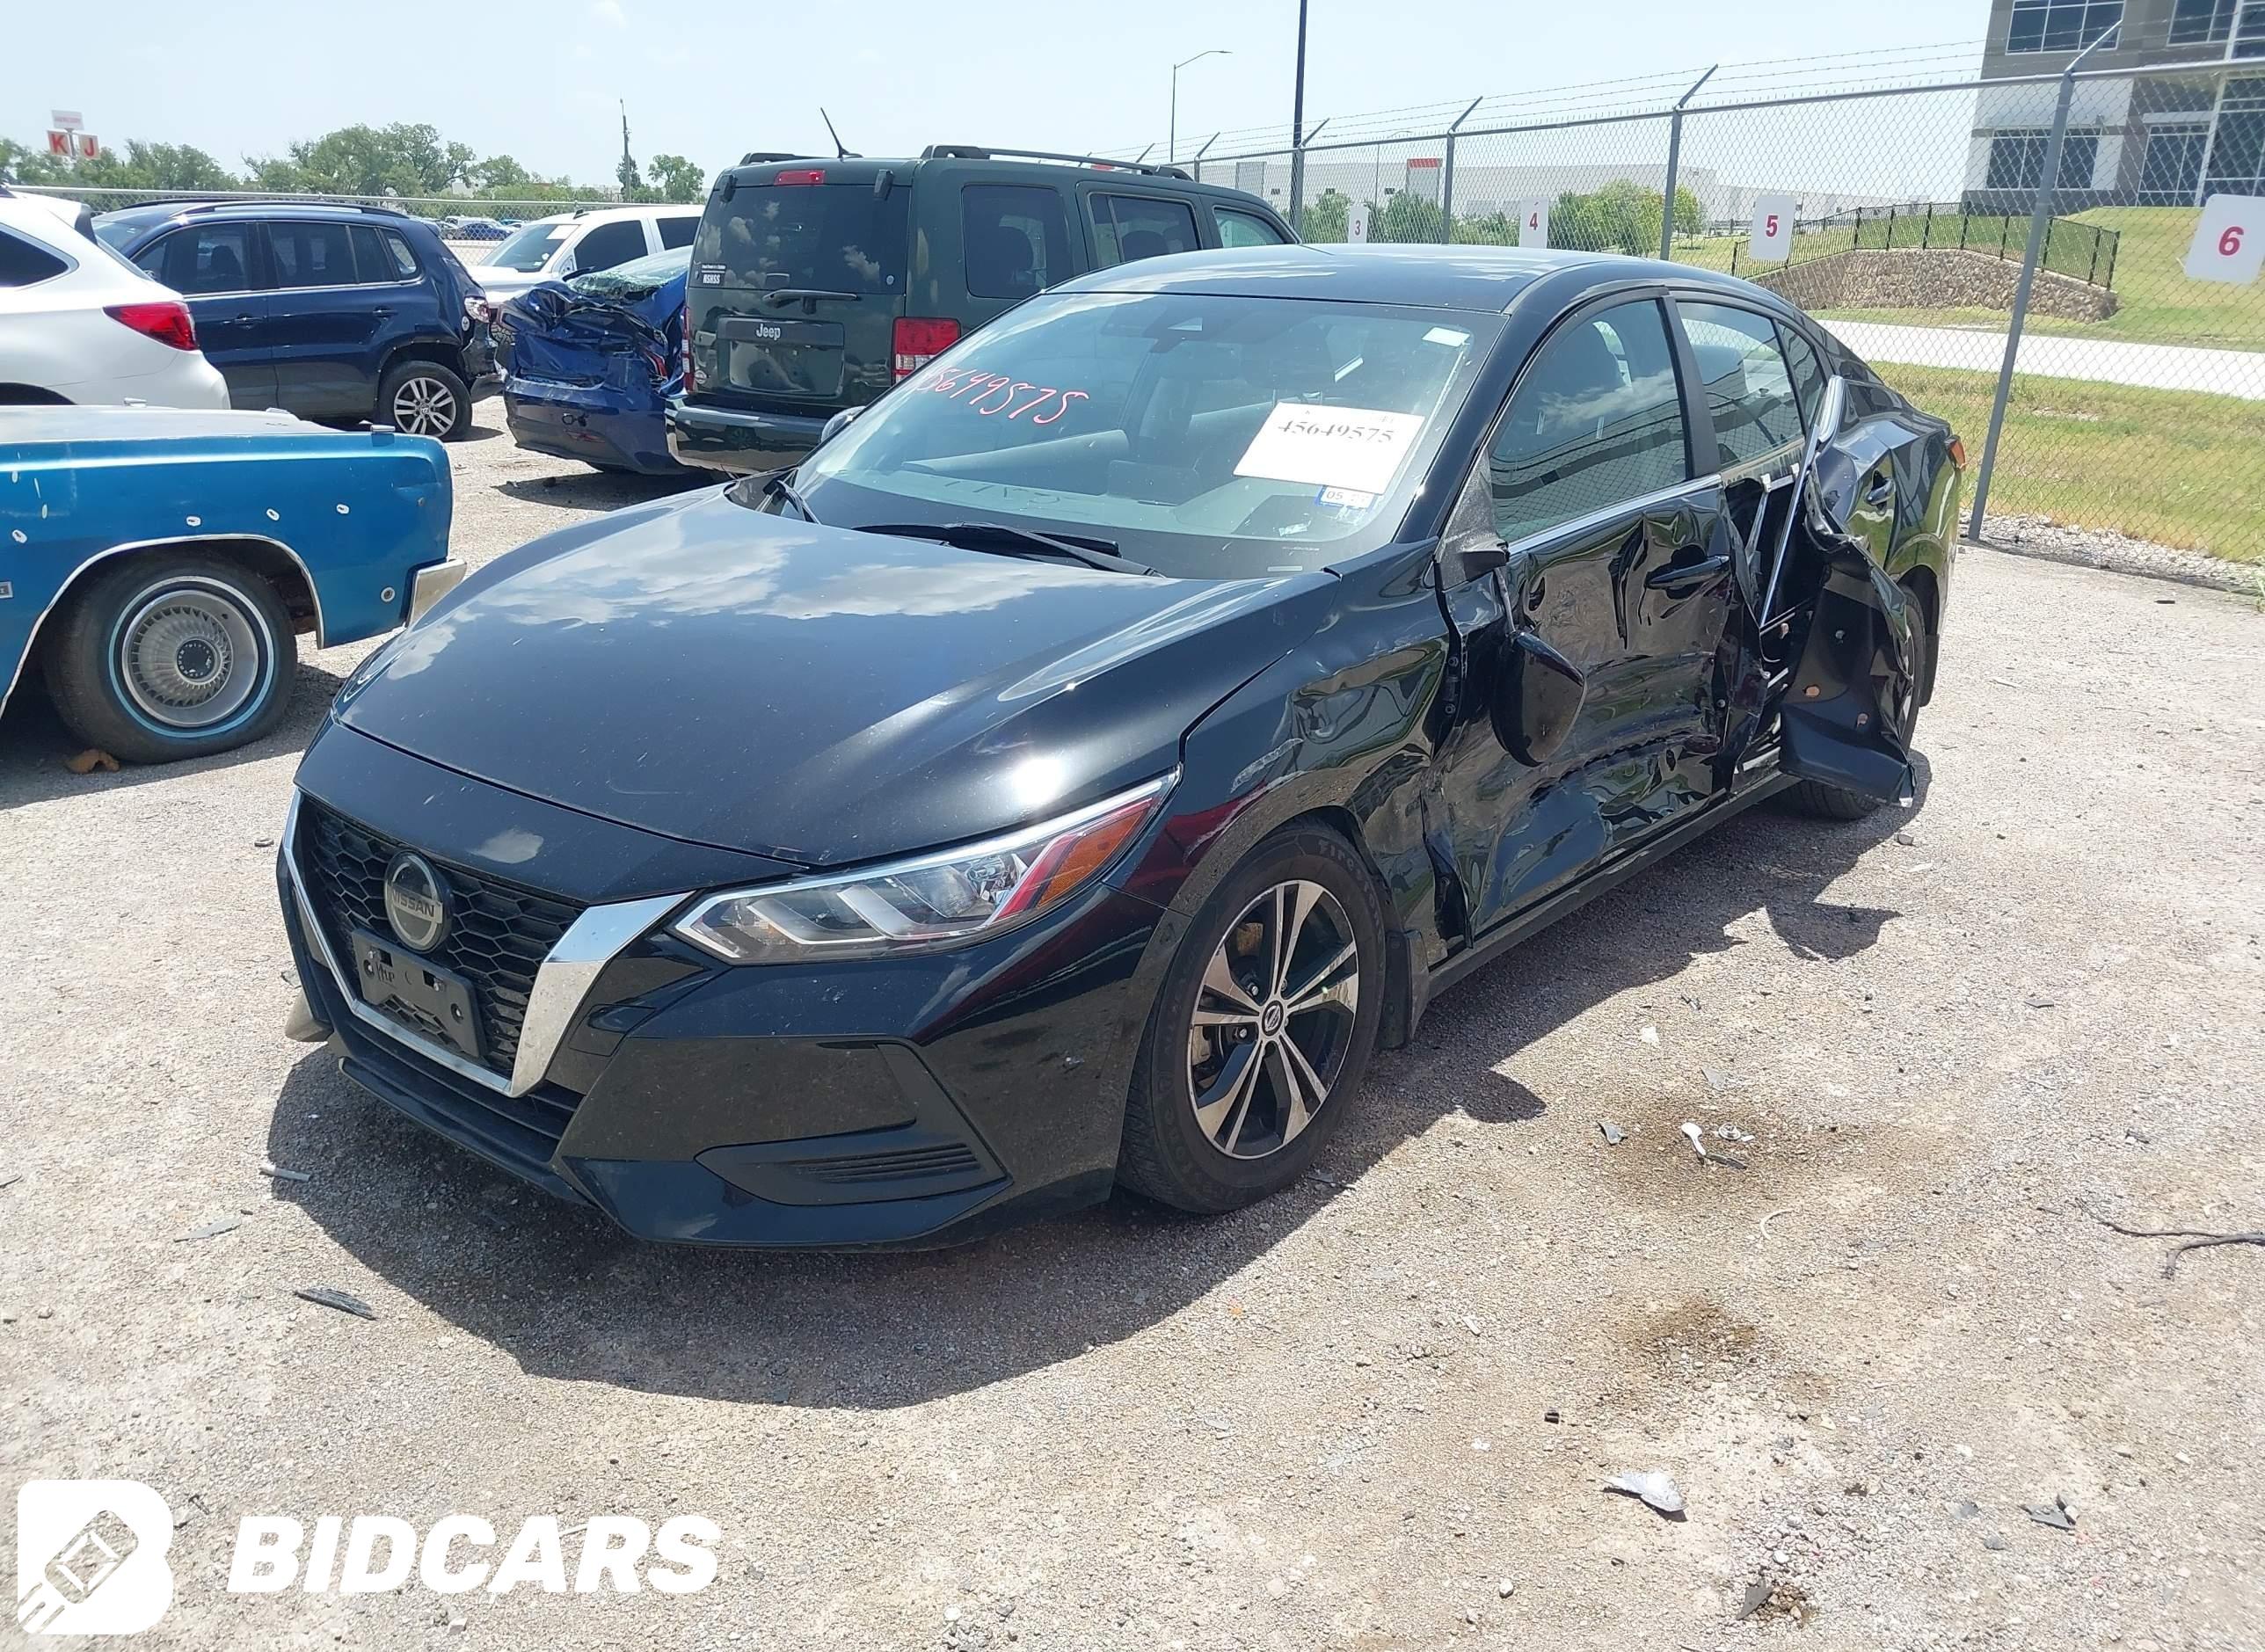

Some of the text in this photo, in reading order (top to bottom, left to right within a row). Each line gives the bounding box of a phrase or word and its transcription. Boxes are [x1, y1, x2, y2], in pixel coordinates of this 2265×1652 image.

[50, 133, 94, 156] K J
[1354, 220, 1361, 236] 3
[1529, 212, 1538, 230] 4
[1766, 215, 1779, 237] 5
[2218, 226, 2244, 256] 6
[756, 323, 781, 341] Jeep
[1278, 420, 1395, 443] 45649575
[1326, 491, 1344, 500] 05
[393, 891, 434, 918] NISSAN
